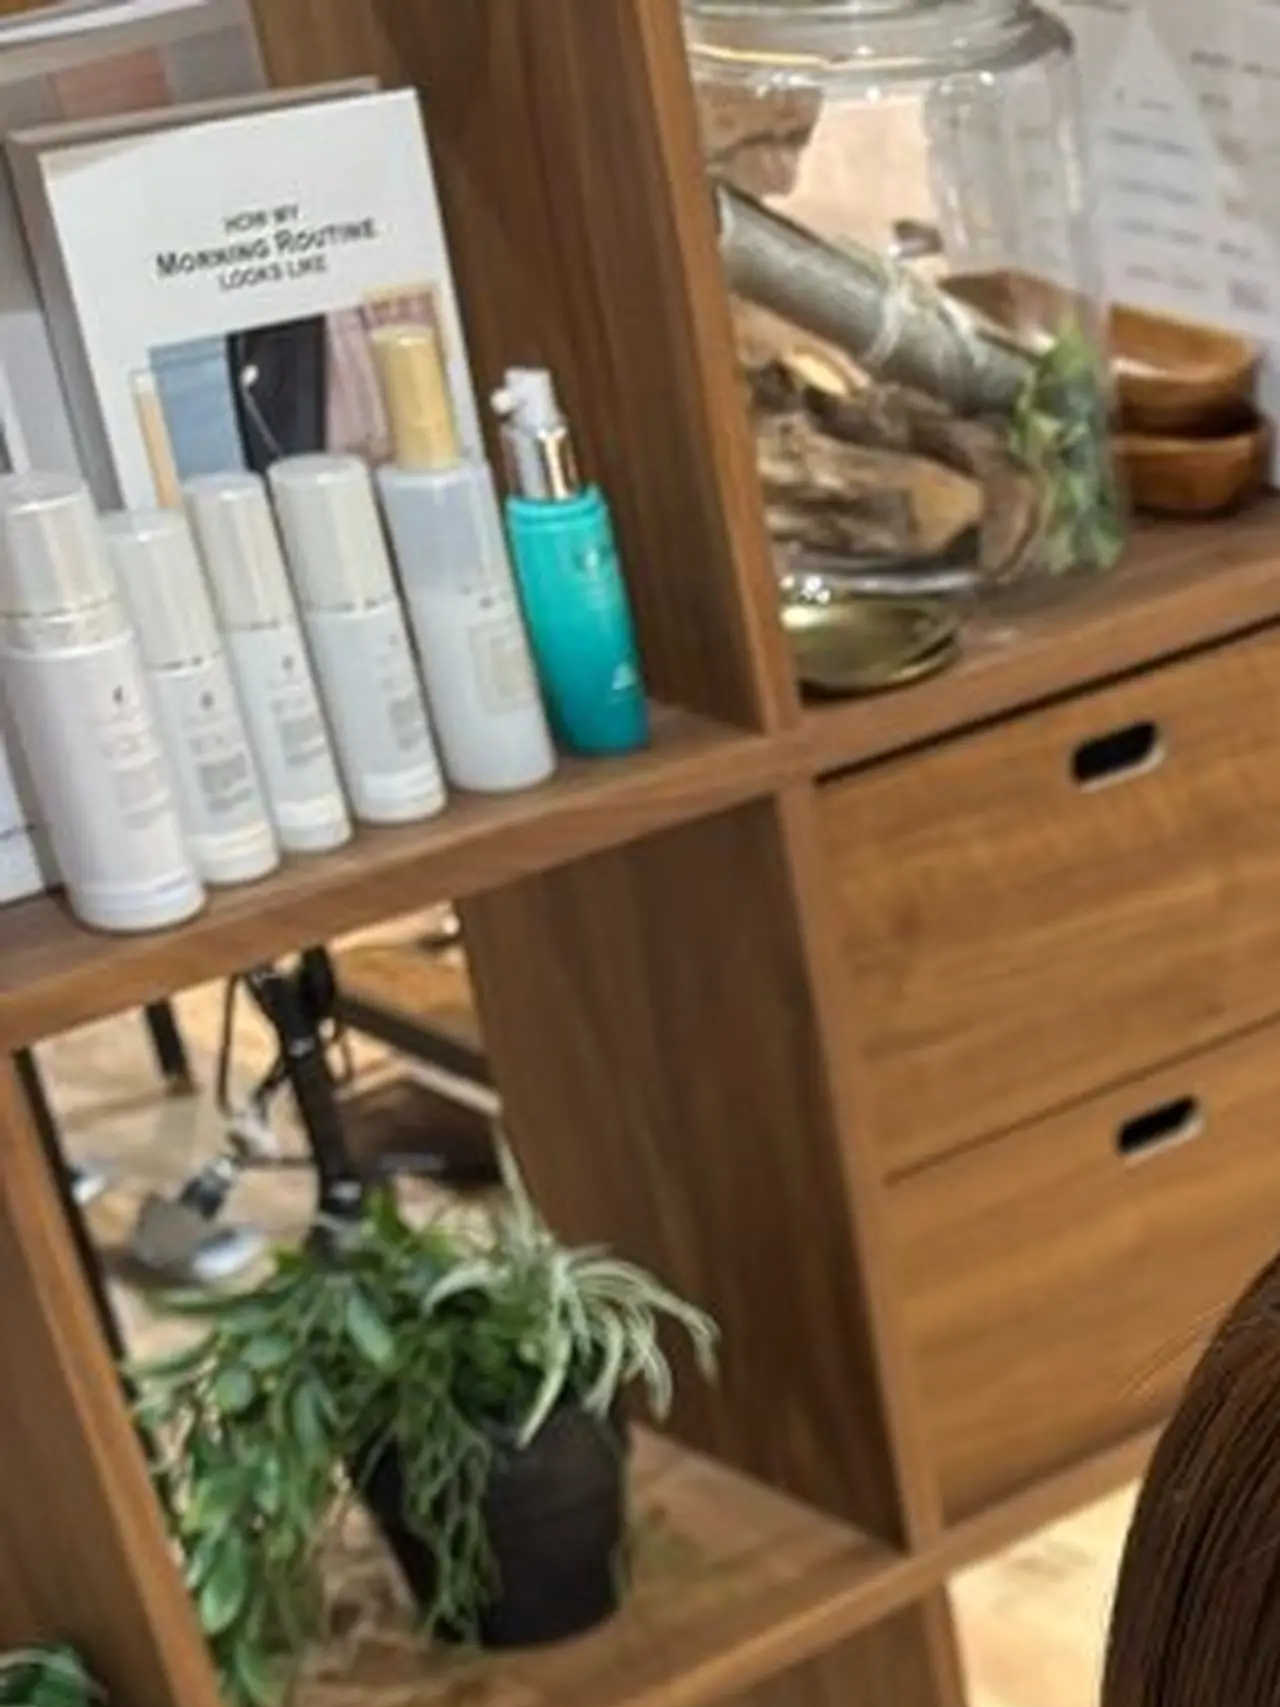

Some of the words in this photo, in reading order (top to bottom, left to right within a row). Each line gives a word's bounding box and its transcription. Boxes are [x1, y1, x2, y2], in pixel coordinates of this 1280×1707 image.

[224, 210, 267, 233] HOW
[273, 204, 299, 224] MY
[156, 238, 270, 276] MORNING
[273, 217, 374, 252] ROUTINE
[219, 262, 281, 291] LOOKS
[287, 254, 327, 278] LIKE
